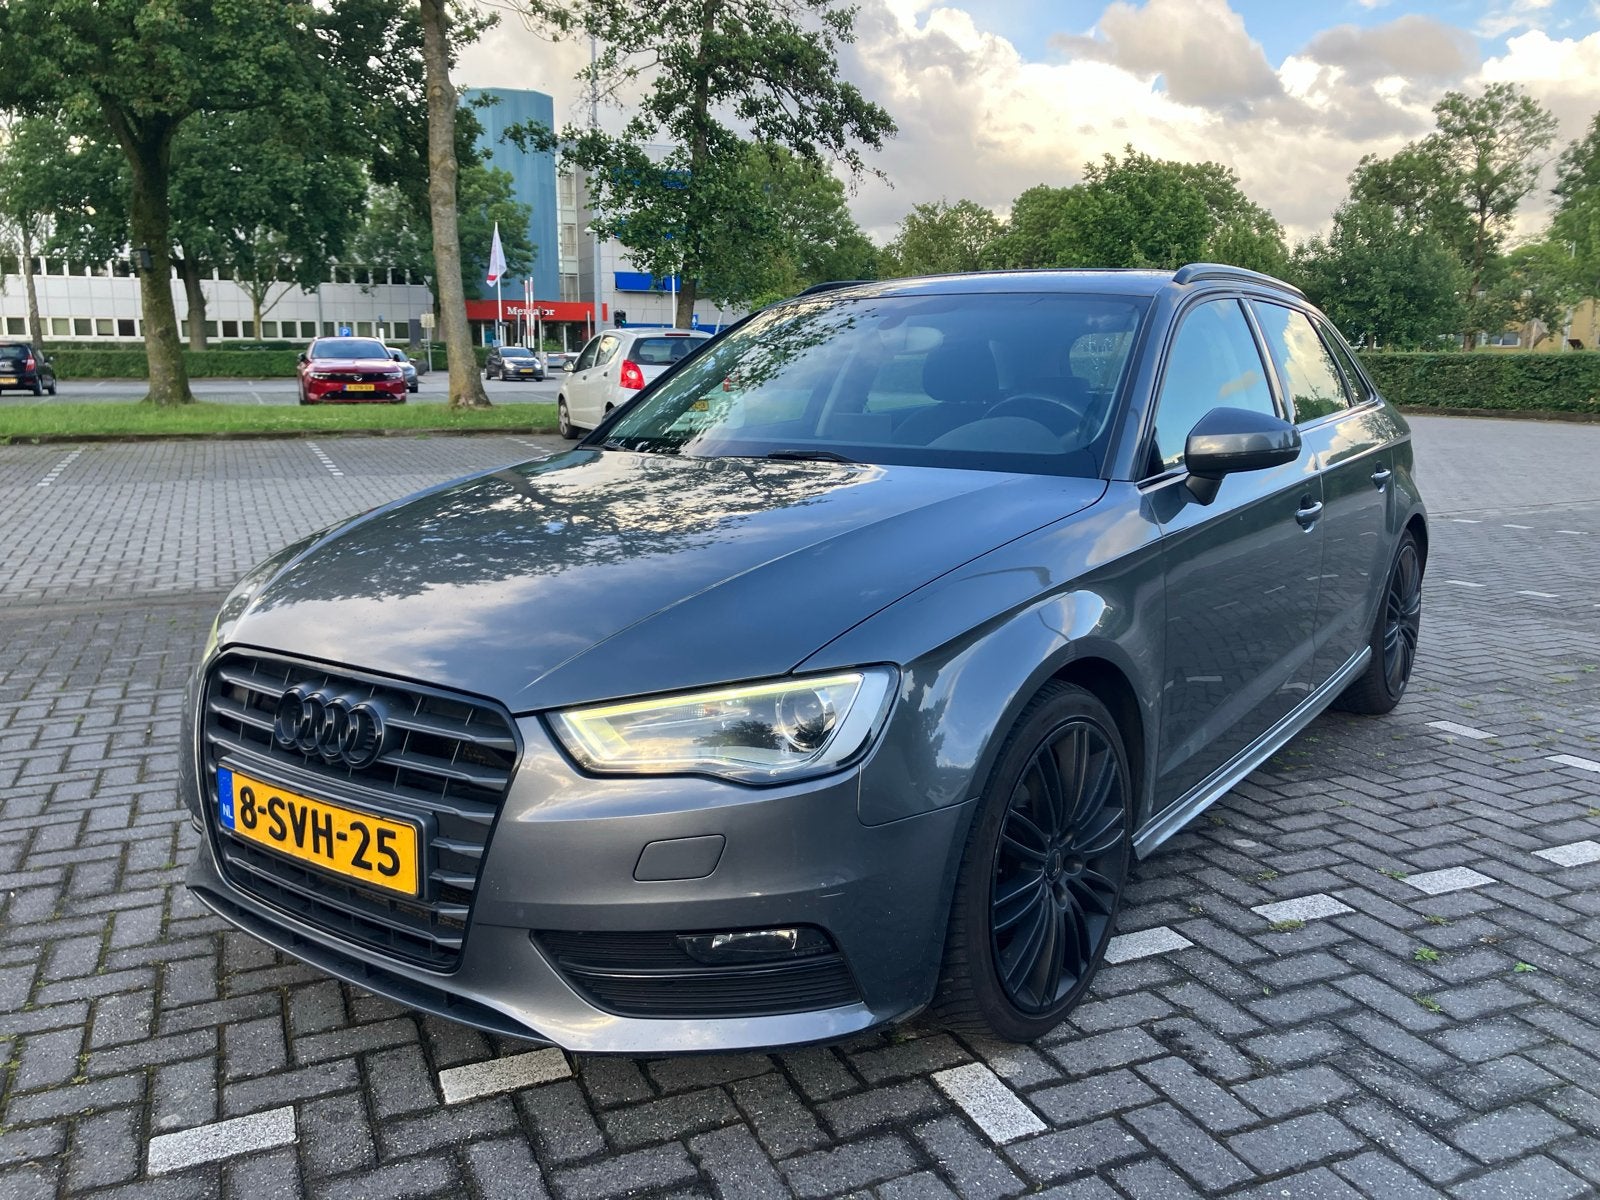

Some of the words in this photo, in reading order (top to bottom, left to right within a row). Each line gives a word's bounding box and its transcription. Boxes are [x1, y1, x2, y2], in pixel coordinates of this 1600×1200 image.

[506, 306, 556, 316] Mercaor
[222, 803, 234, 819] NL
[240, 786, 401, 877] 8-SVH-25
